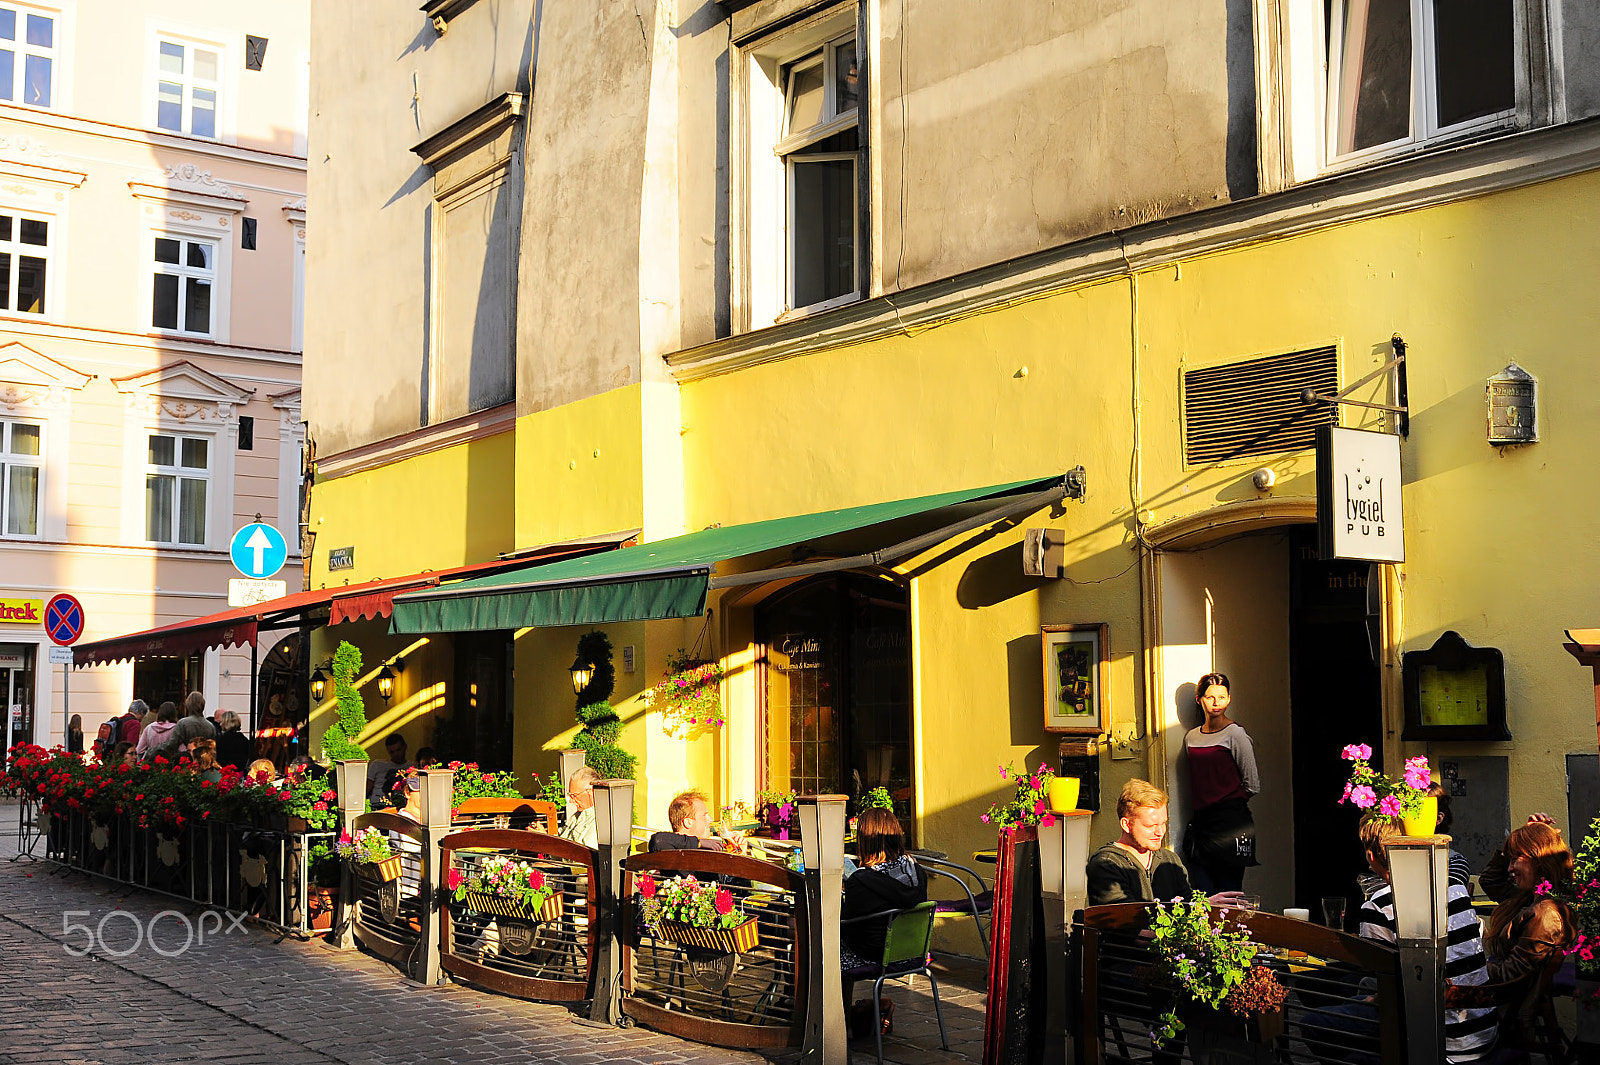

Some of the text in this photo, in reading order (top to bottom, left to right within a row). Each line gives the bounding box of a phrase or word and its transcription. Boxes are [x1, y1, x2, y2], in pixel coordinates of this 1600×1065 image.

[1344, 473, 1385, 523] tygiel
[1347, 523, 1385, 537] PUB
[1328, 571, 1343, 588] in
